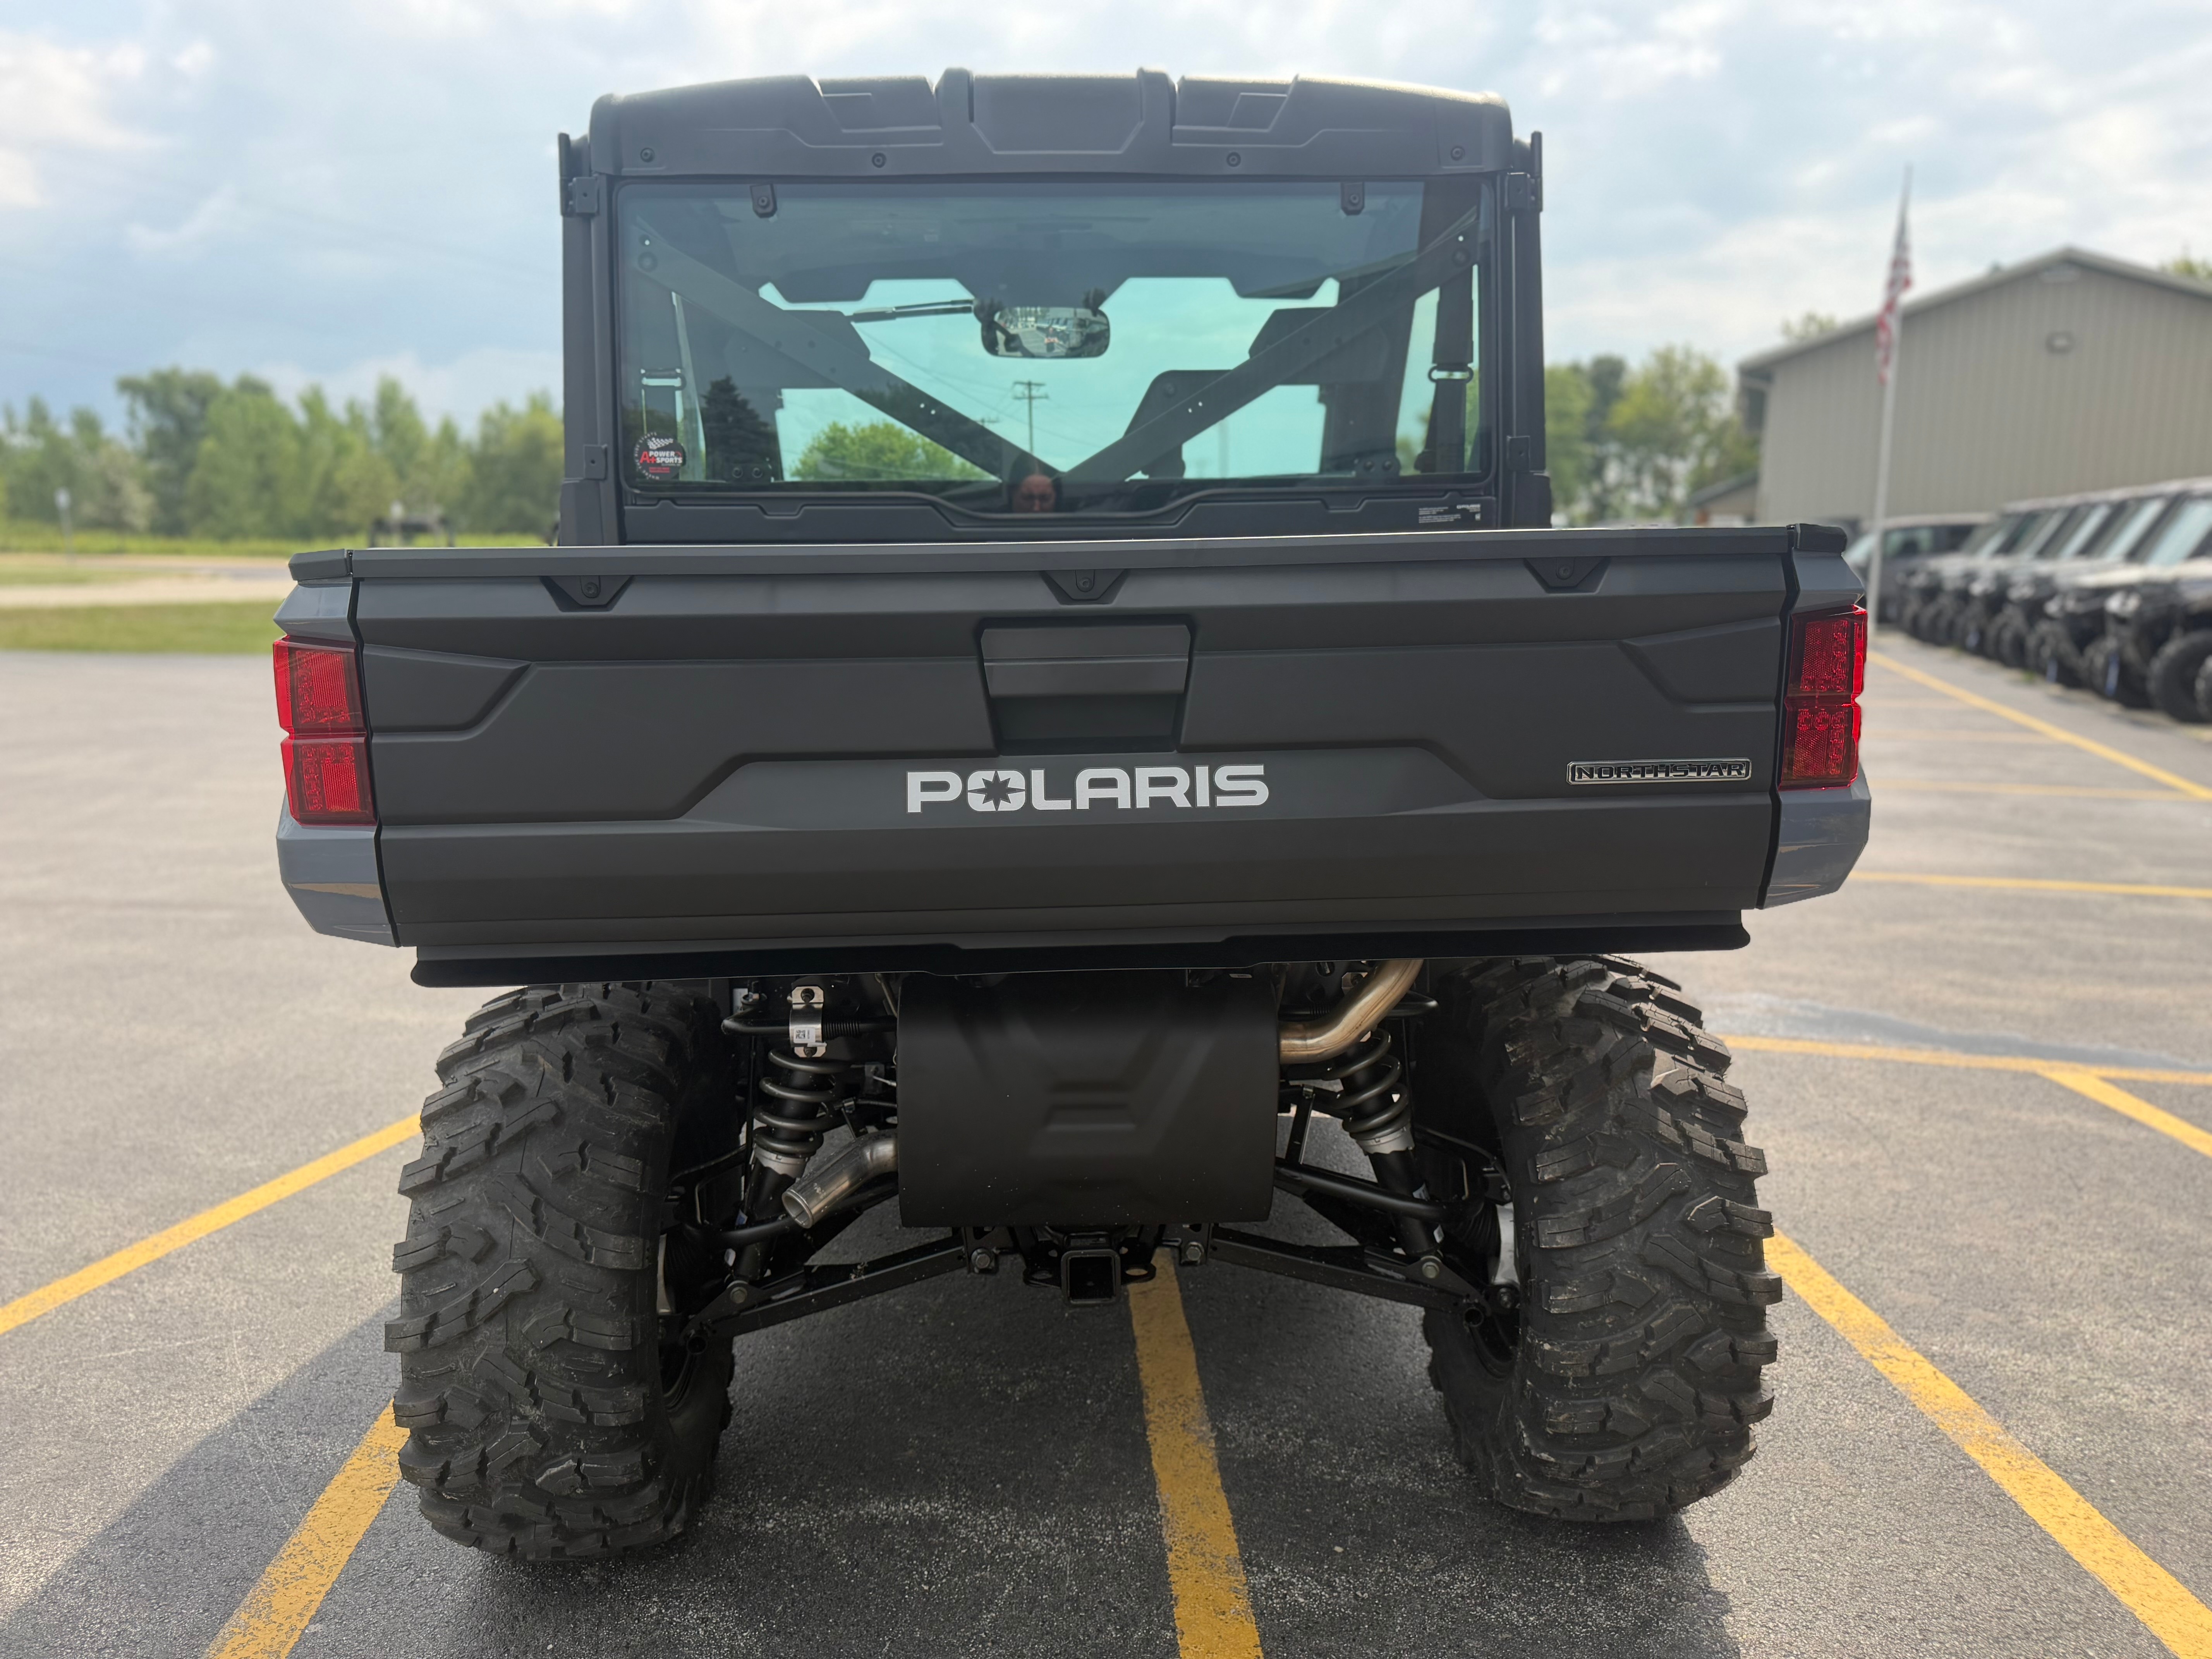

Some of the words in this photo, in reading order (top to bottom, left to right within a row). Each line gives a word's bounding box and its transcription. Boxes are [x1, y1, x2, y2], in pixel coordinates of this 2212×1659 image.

[639, 432, 657, 443] STARTS
[639, 451, 656, 464] A+
[1576, 762, 1745, 780] NORTHSTAR
[906, 764, 1269, 813] POLARIS
